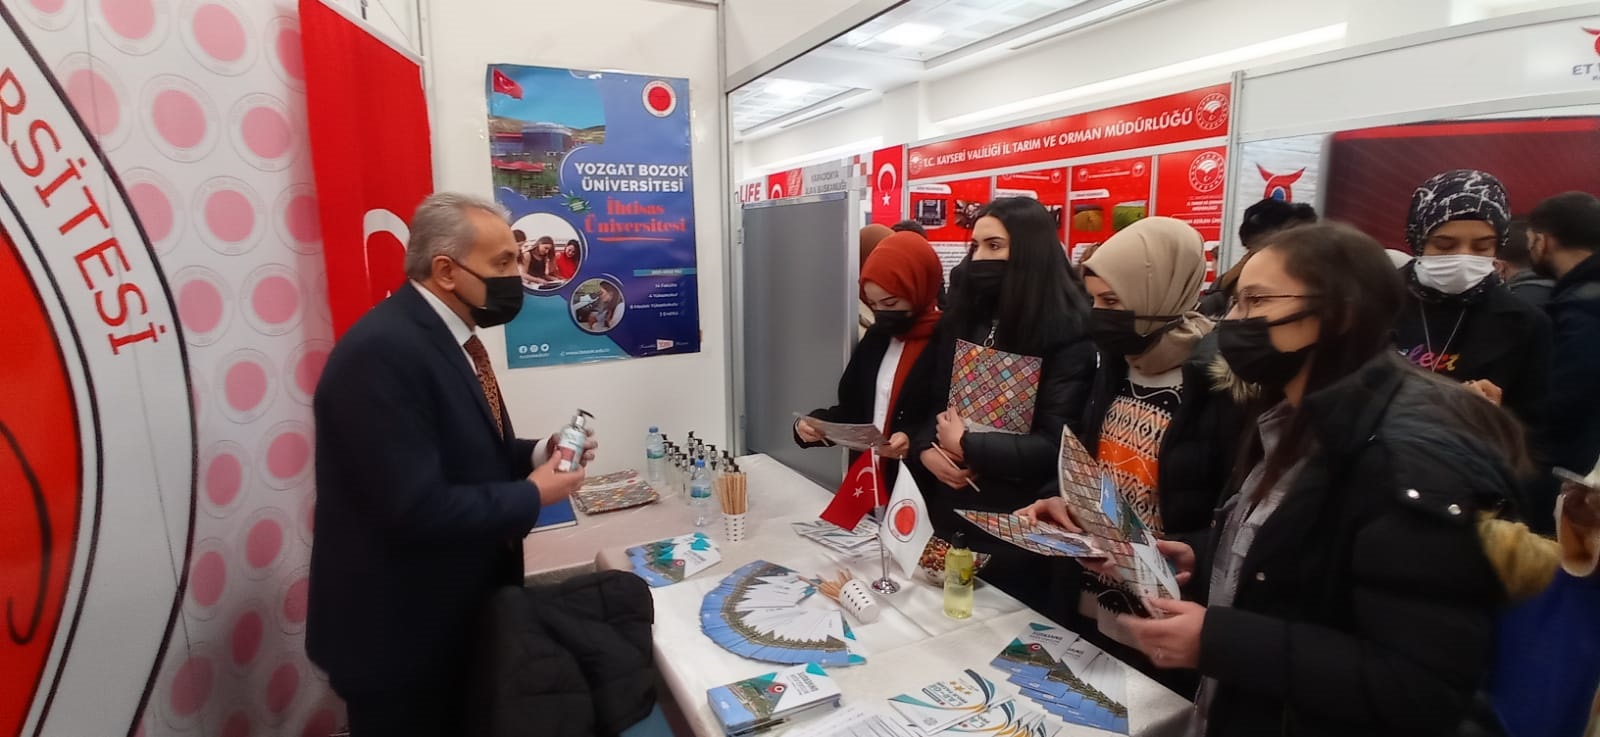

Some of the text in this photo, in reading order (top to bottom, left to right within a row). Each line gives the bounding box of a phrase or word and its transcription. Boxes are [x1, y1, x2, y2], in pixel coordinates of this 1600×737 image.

[1572, 63, 1593, 75] ET
[936, 149, 966, 166] KAYSERİ
[967, 142, 1001, 161] VALİLİĞİ
[1003, 141, 1010, 155] İL
[1012, 138, 1041, 154] TARIM
[1043, 135, 1057, 148] VE
[1058, 127, 1102, 146] ORMAN
[1104, 108, 1193, 138] MÜDÜRLÜĞÜ
[574, 162, 689, 177] YOZGAT BOZOK
[581, 176, 684, 193] ÜNİVERSİTESİ
[607, 196, 665, 215] İhtisas
[585, 214, 686, 233] Üniversitesi
